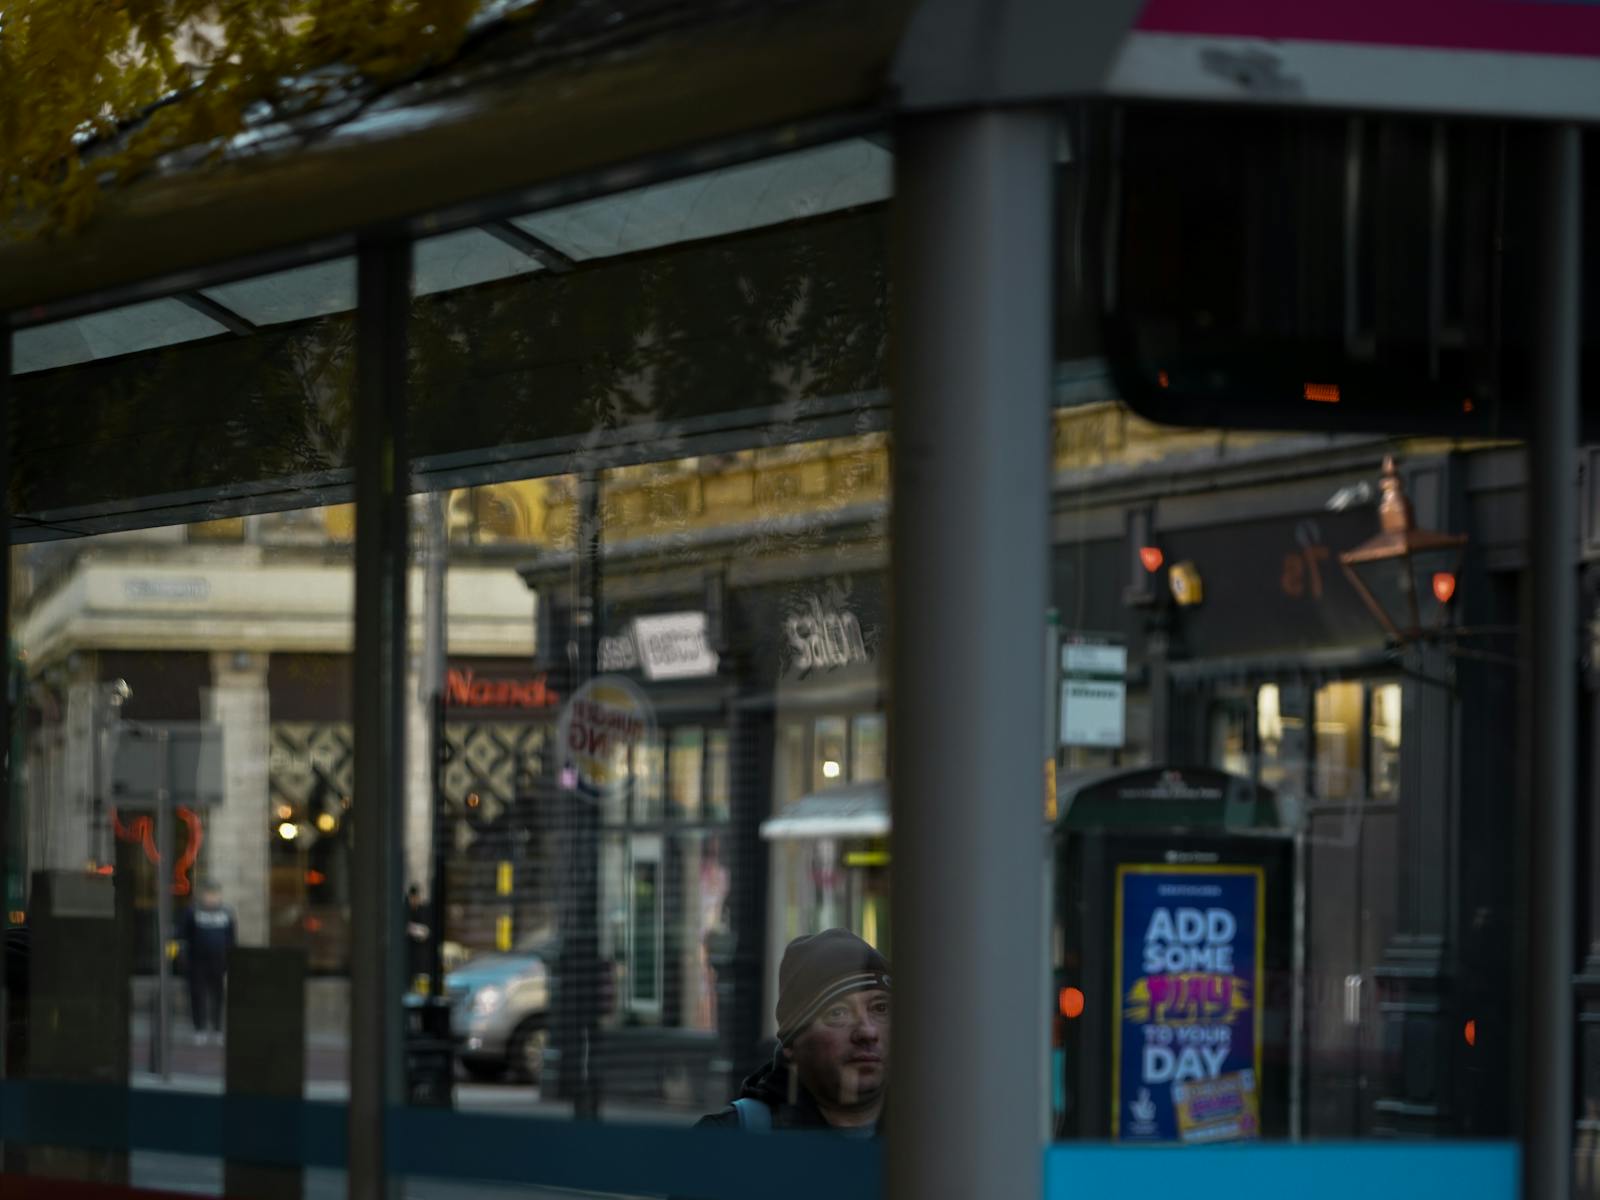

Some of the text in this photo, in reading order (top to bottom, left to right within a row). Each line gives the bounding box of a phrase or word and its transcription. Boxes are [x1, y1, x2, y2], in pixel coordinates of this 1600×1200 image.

[1144, 906, 1237, 944] ADD
[1142, 942, 1234, 974] SOME
[1147, 976, 1233, 1019] PLAY
[1142, 1024, 1232, 1047] TO YOUR
[1142, 1045, 1232, 1084] DAY
